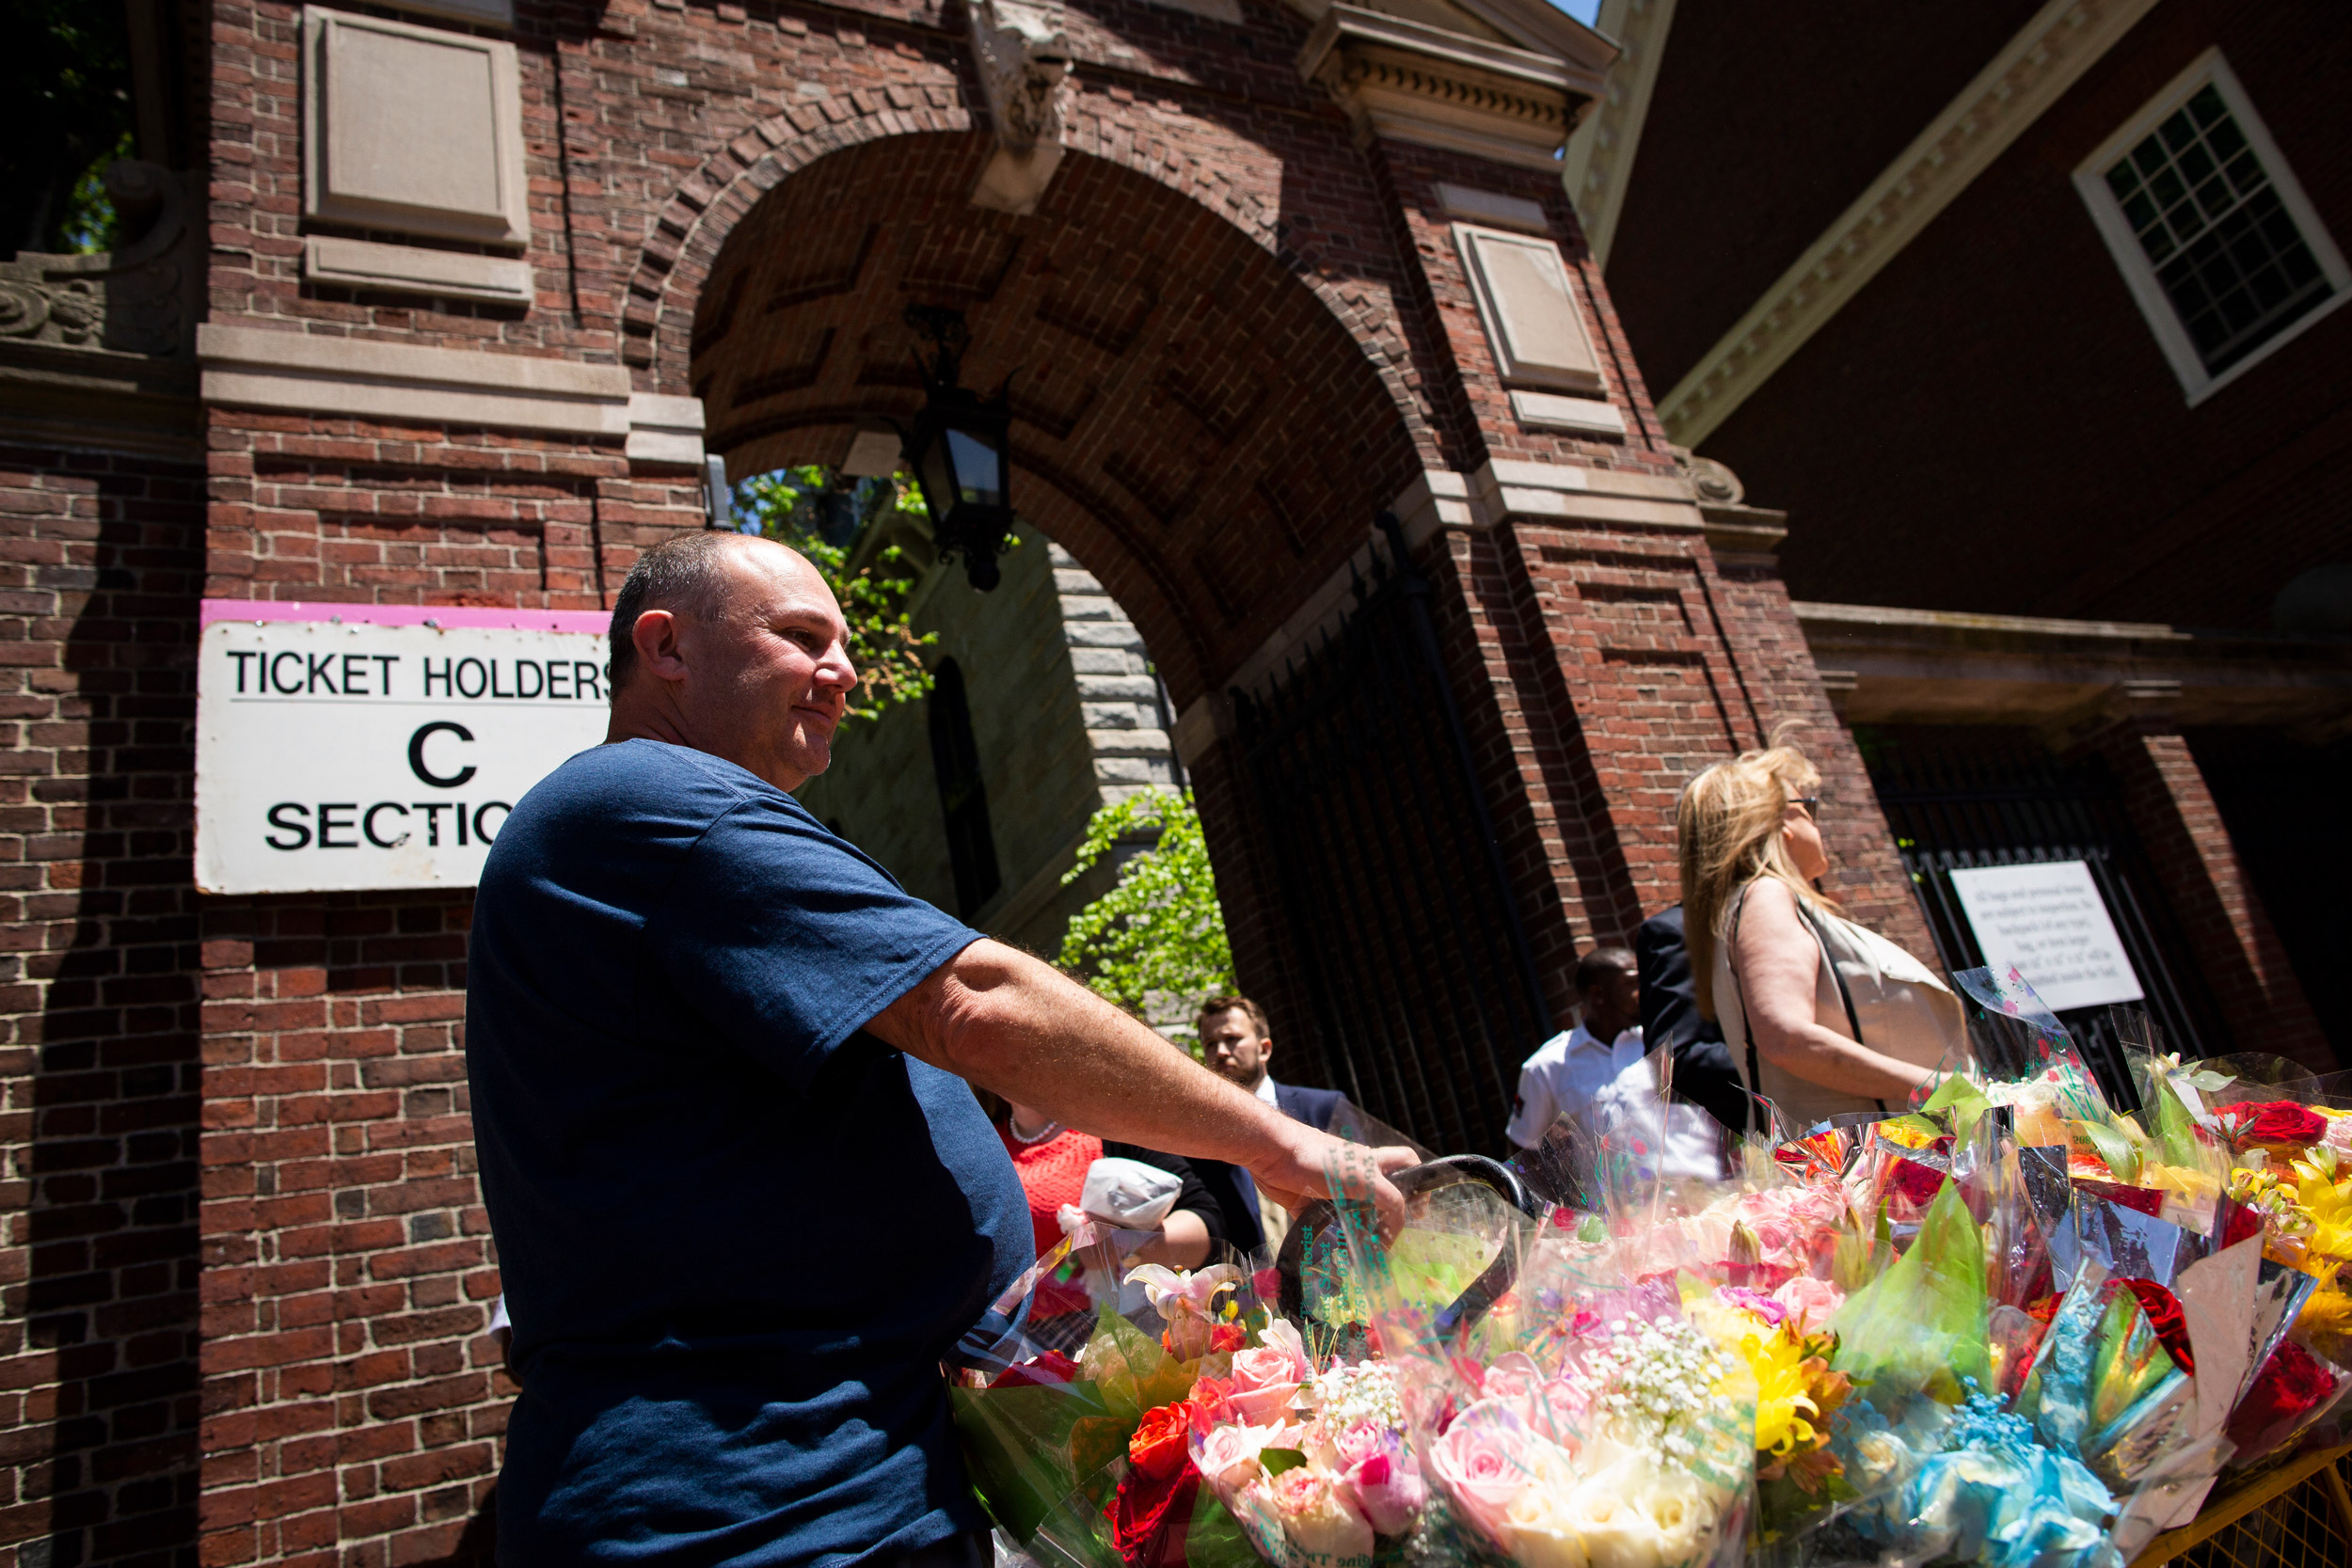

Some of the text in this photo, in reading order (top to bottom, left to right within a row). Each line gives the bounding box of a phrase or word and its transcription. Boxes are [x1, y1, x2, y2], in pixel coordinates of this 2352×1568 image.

[226, 651, 401, 696] TICKET
[407, 721, 478, 788] C
[265, 801, 513, 850] SECTIO
[1299, 1225, 1313, 1277] Florist
[1317, 1242, 1331, 1291] Street
[1336, 1228, 1349, 1277] 01810
[1299, 1280, 1313, 1319] That
